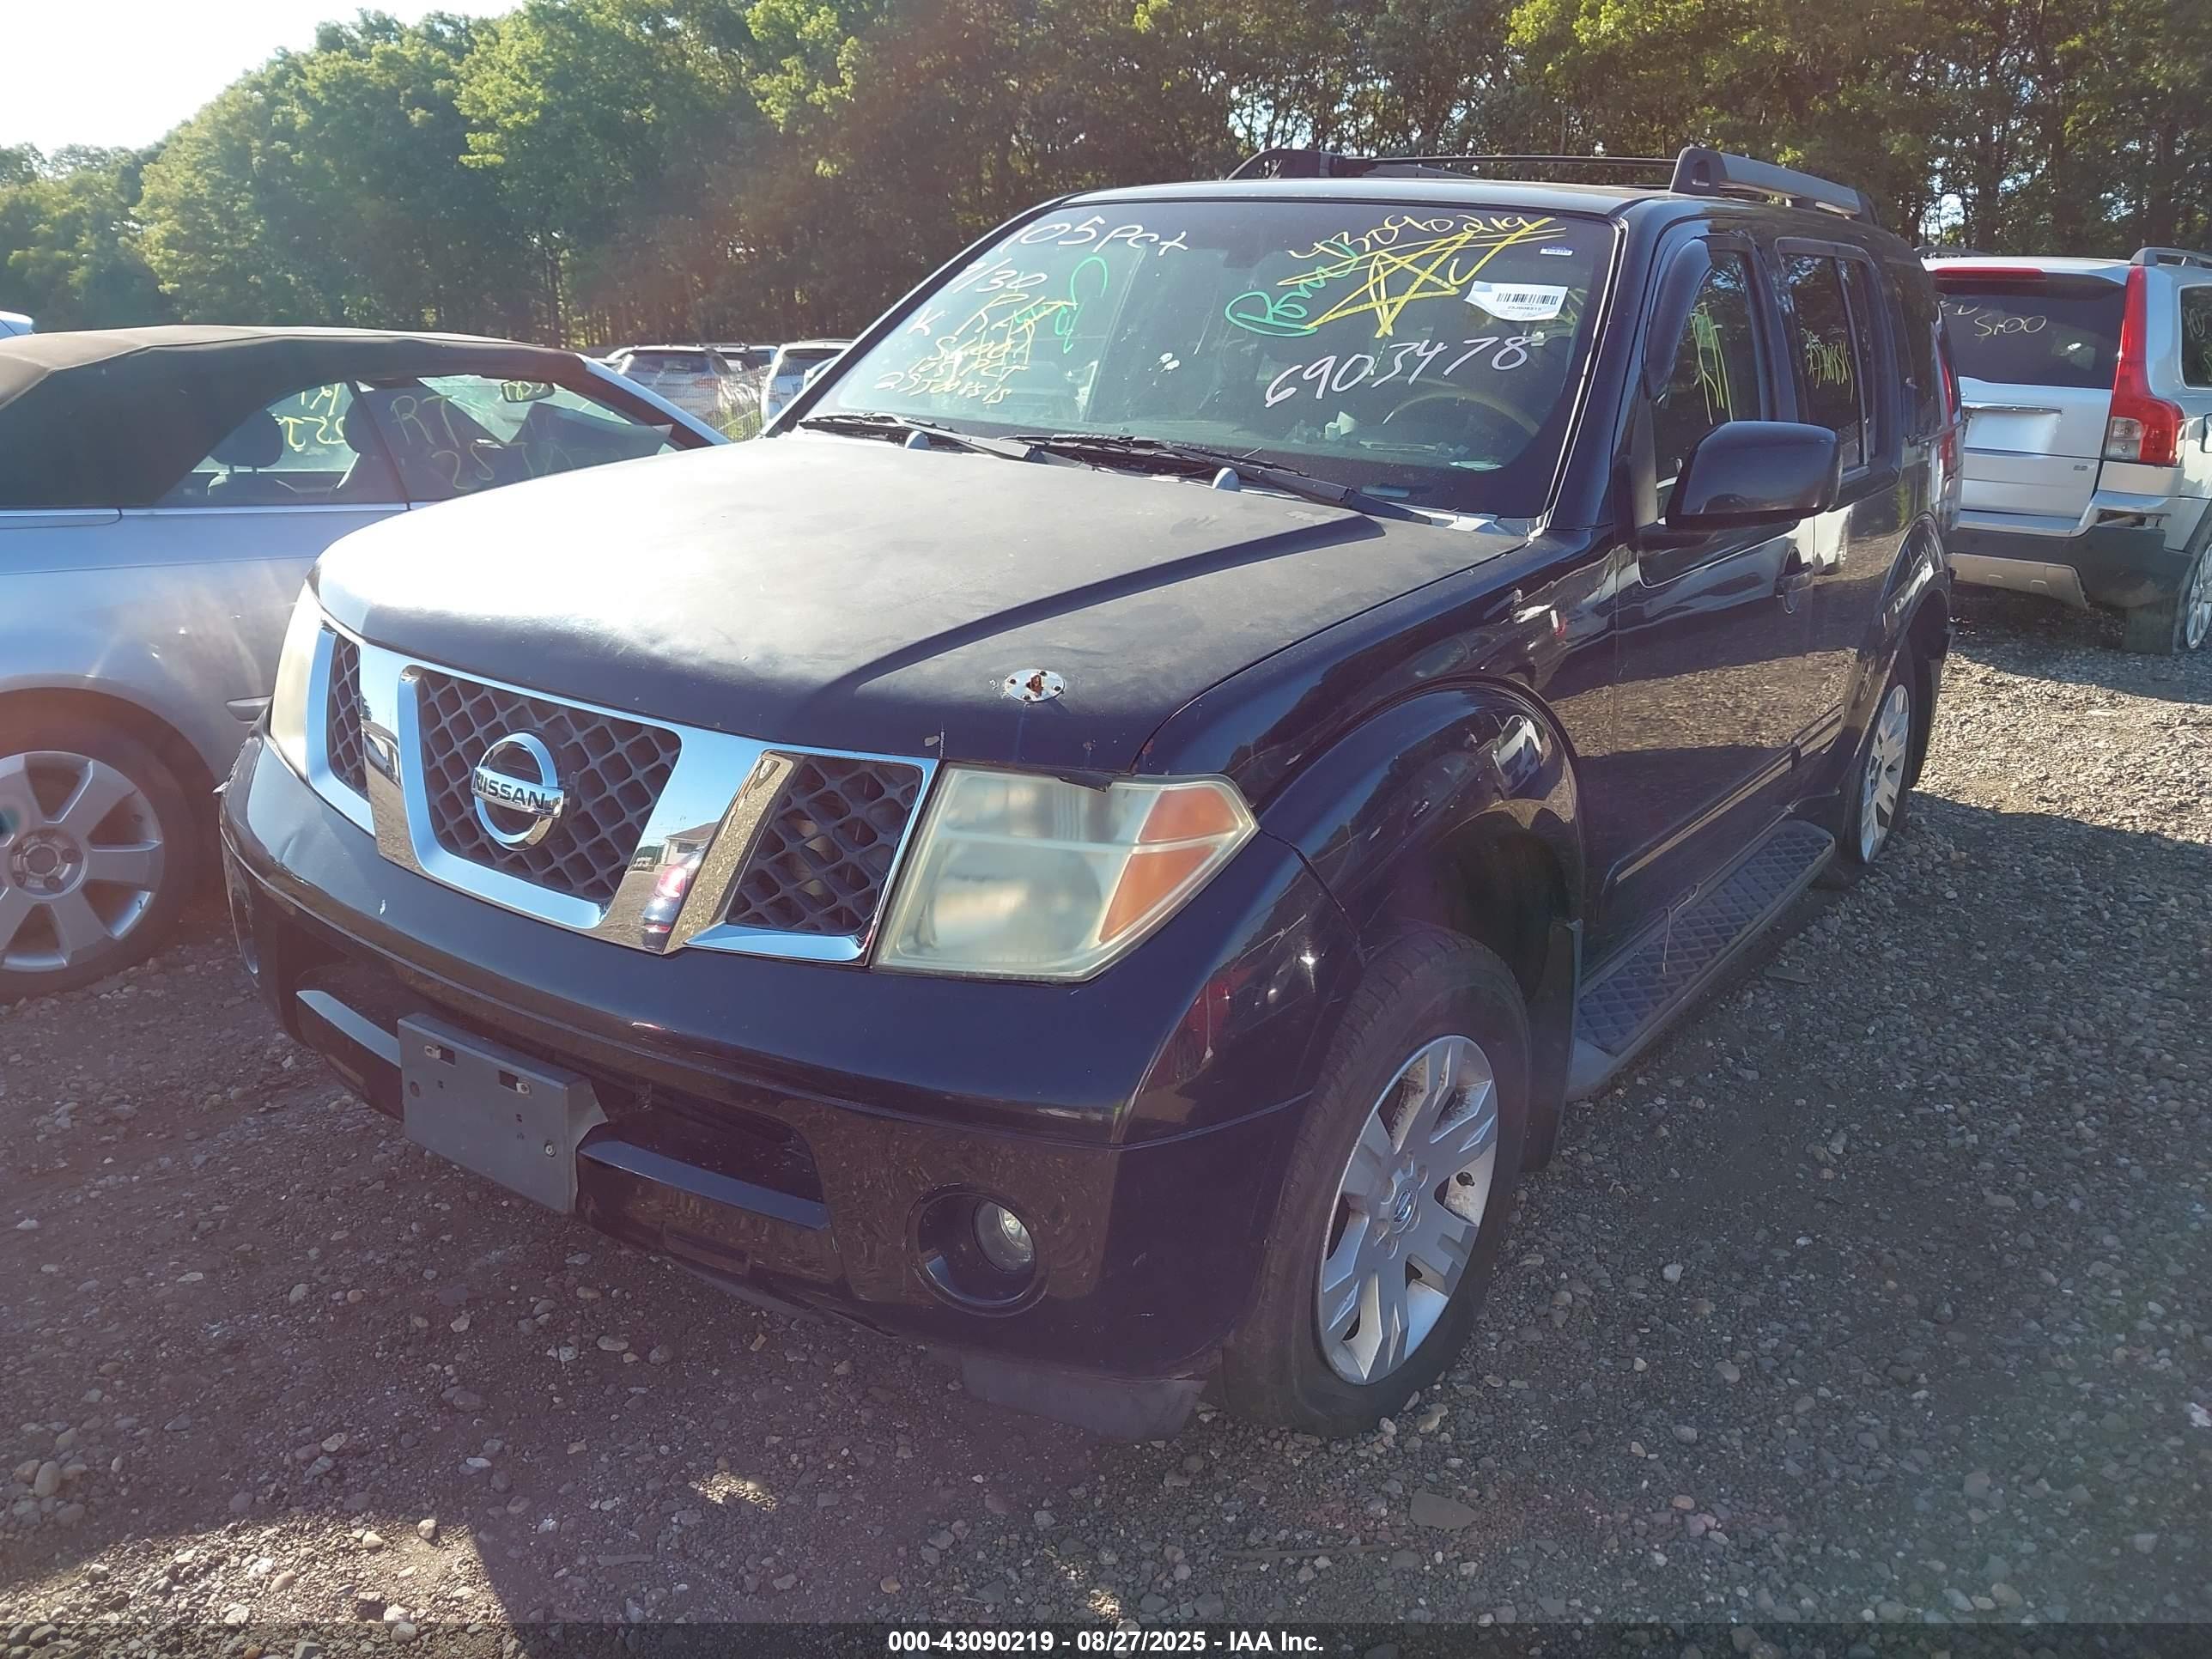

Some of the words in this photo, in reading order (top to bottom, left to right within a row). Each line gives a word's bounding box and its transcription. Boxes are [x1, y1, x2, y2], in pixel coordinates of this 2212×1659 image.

[1287, 214, 1539, 259] 43090219
[1265, 335, 1535, 409] 6903478
[473, 773, 545, 811] NISSAN
